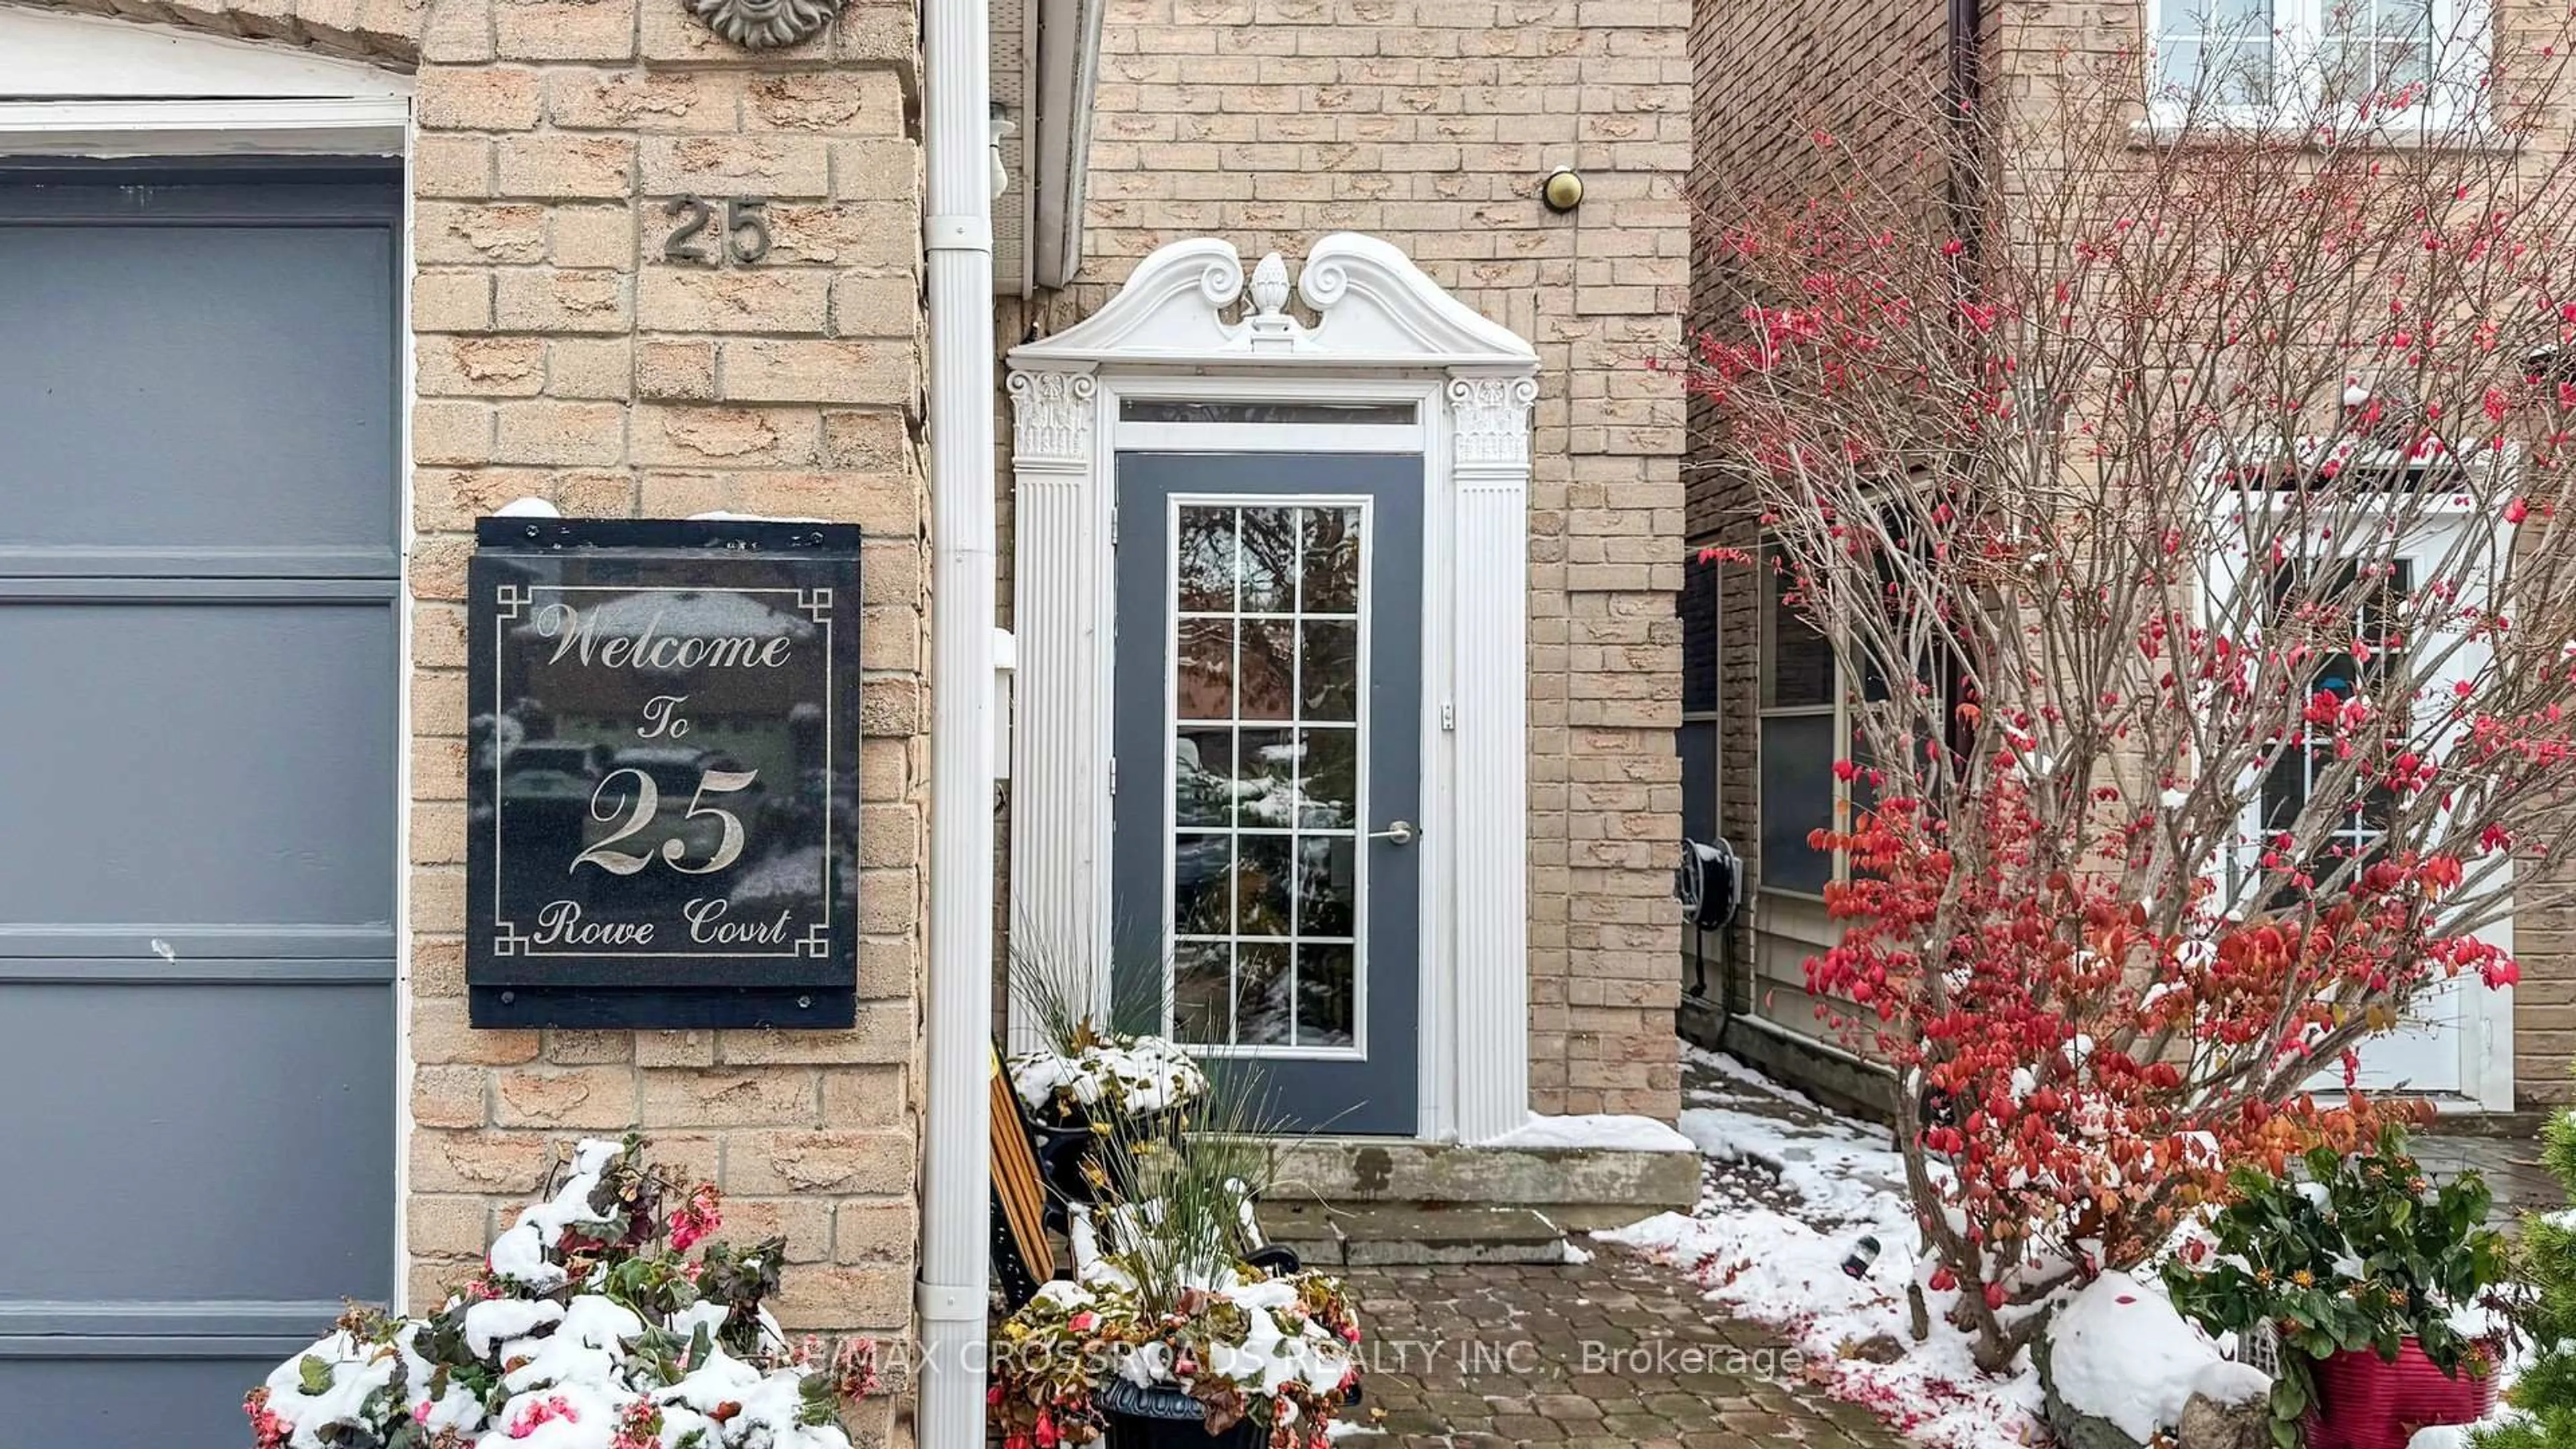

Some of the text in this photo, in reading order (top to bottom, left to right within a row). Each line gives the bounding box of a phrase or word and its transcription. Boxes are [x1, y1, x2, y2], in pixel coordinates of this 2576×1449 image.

[663, 191, 771, 262] 25
[537, 603, 792, 668] Welcome
[637, 695, 689, 739] To
[569, 768, 759, 875] 25
[534, 898, 792, 945] Rowe Court
